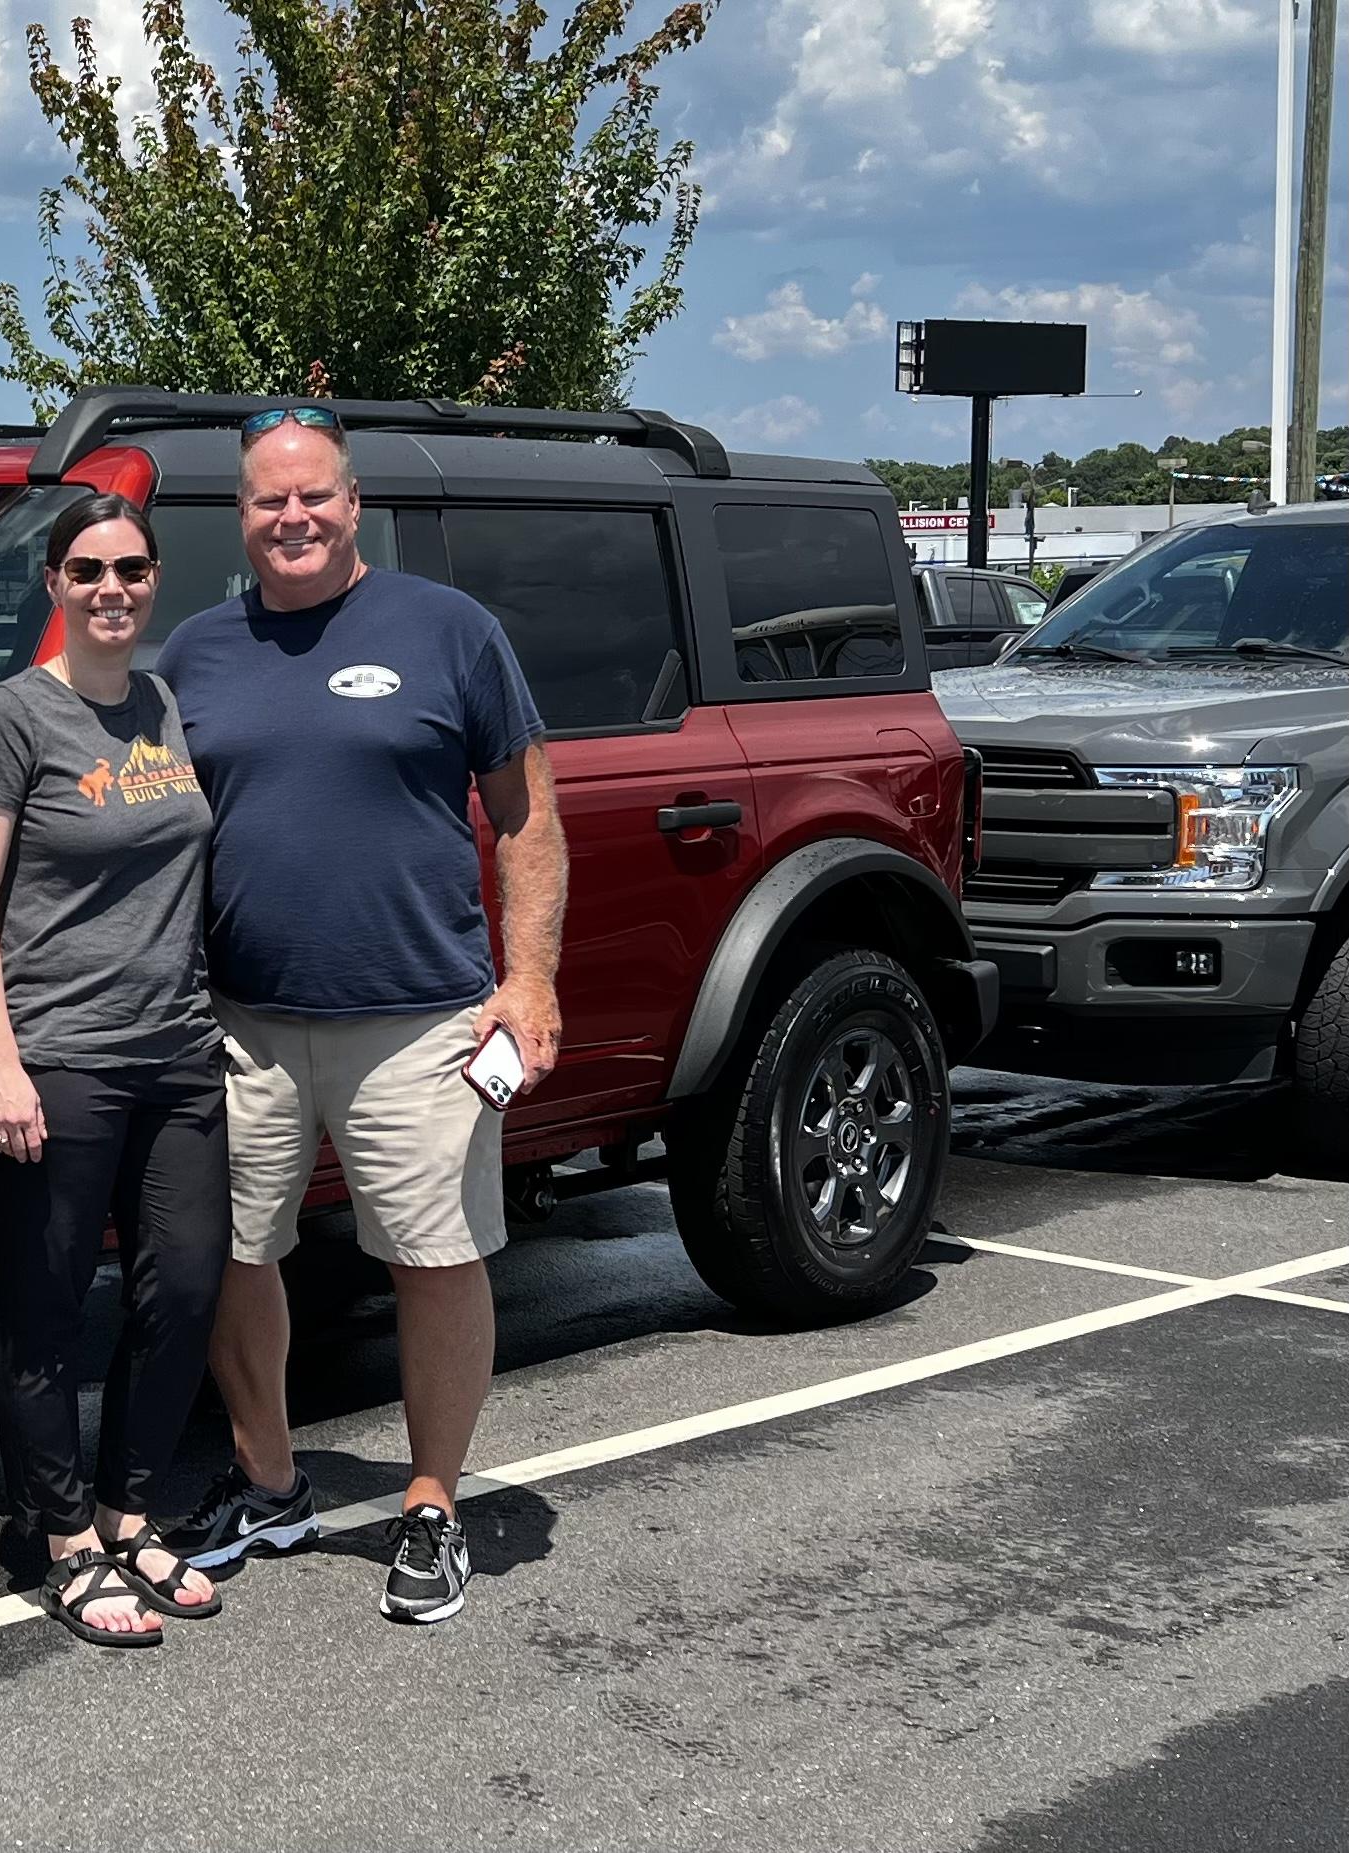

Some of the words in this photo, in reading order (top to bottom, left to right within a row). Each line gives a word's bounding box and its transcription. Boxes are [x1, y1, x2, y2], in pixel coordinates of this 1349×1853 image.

[899, 517, 945, 528] LLISION
[118, 764, 195, 786] BRONCO
[123, 783, 168, 805] BUILT
